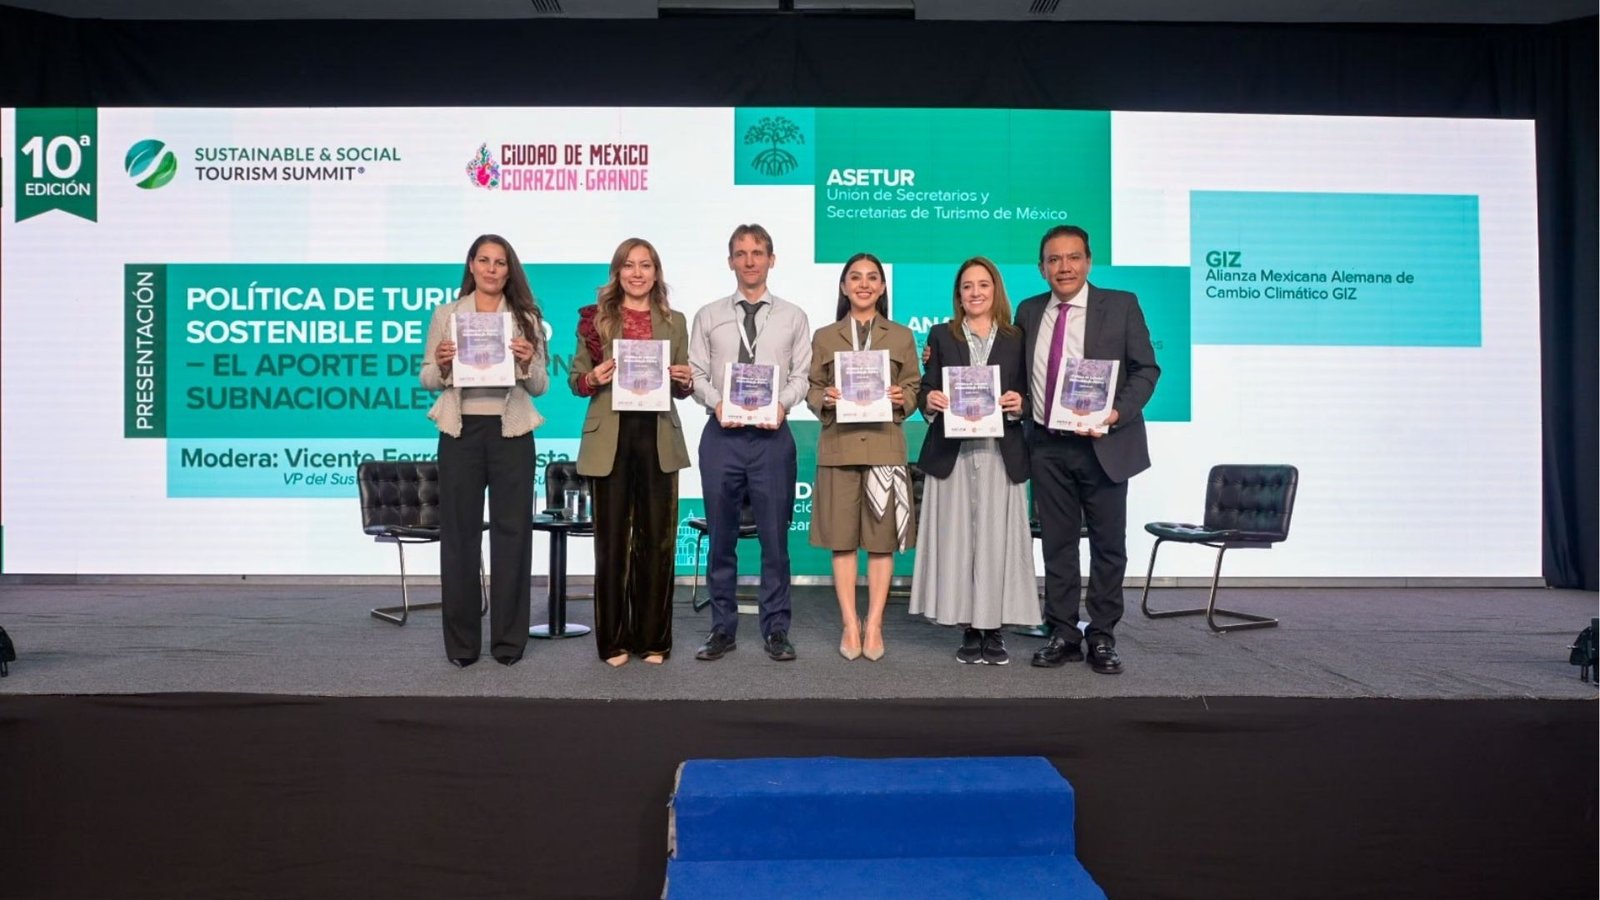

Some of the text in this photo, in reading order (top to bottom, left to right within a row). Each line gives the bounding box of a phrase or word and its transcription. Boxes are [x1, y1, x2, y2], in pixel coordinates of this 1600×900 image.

[194, 147, 402, 162] SUSTAINABLE & SOCIAL
[564, 144, 583, 166] DE
[194, 166, 278, 181] TOURISM
[501, 167, 649, 192] CORAZÓN GRANDE
[826, 168, 916, 186] ASETUR
[25, 179, 91, 196] EDICIÓN
[826, 187, 990, 205] Unión de Secretarios y
[826, 204, 1069, 221] Secretarias de Turismo de México
[1205, 250, 1242, 268] GIZ
[1205, 268, 1415, 284] Alianza Mexicana Alemana de
[187, 280, 326, 311] POLÍTICA
[333, 287, 375, 311] DE
[1205, 285, 1358, 301] Cambio Climático GIZ
[186, 319, 423, 344] SOSTENIBLE DE
[131, 271, 154, 430] PRESENTACIÓN
[213, 353, 247, 377] EL
[254, 353, 378, 377] APORTE
[386, 353, 424, 377] DE
[181, 447, 279, 468] Modera:
[284, 447, 376, 468] Vicente
[283, 472, 303, 486] VP
[305, 472, 328, 486] del
